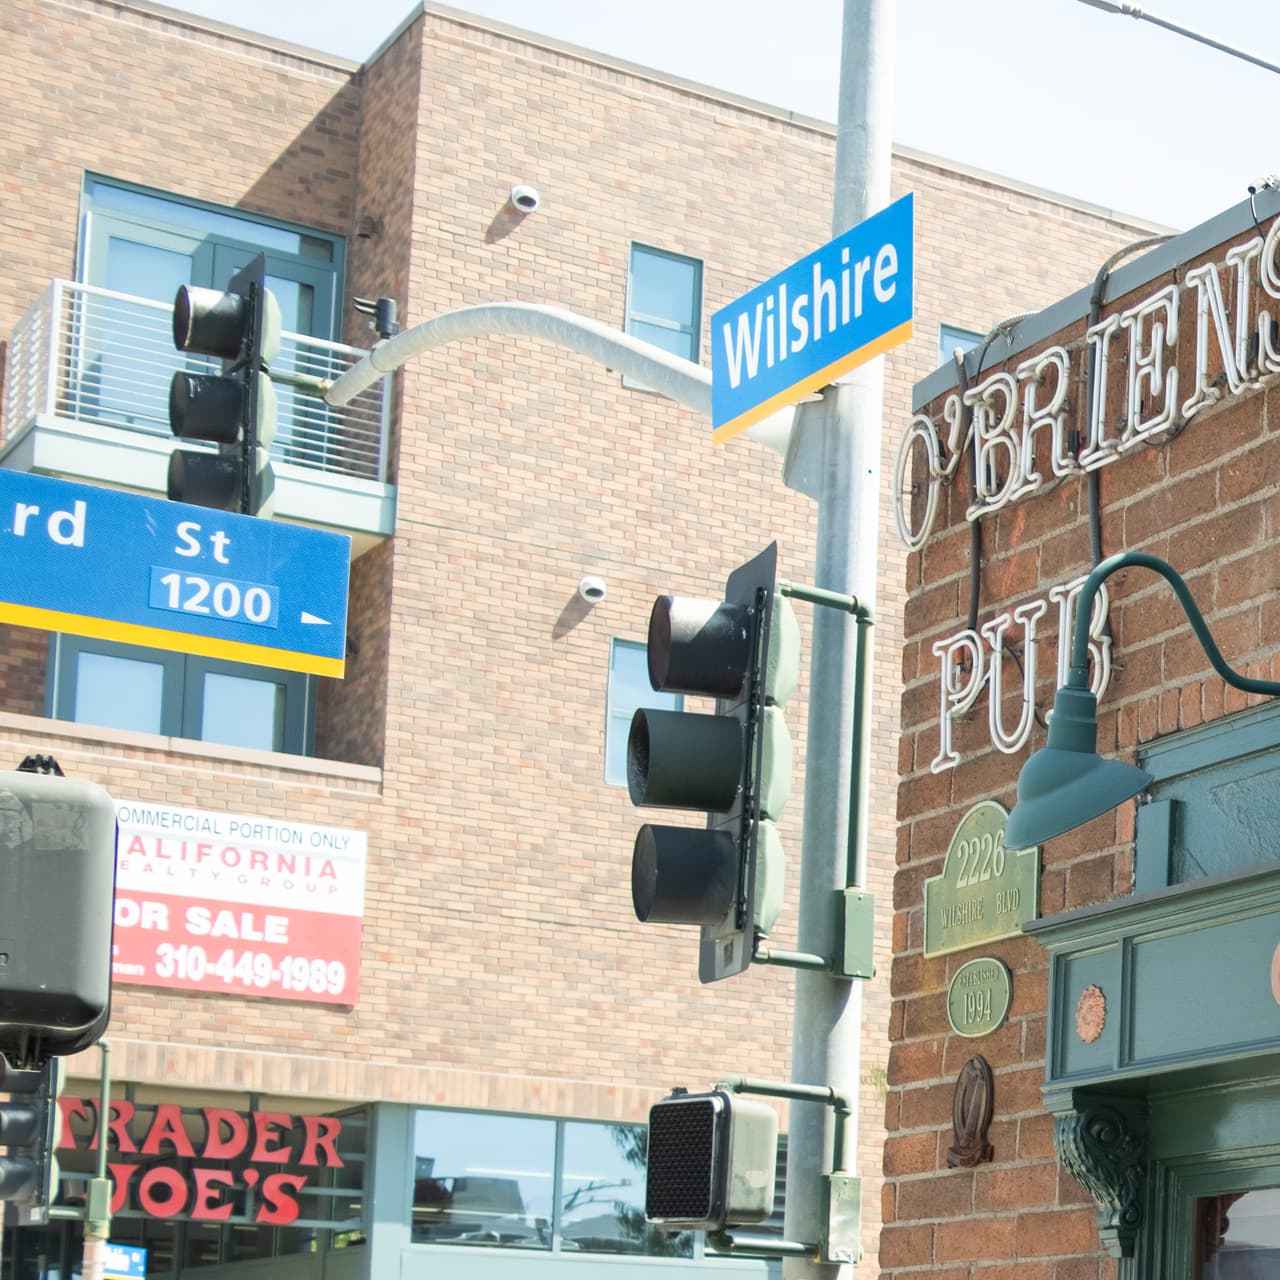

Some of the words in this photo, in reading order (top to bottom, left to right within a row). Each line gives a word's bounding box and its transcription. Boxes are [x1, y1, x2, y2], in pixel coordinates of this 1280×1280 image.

[723, 240, 900, 388] Wilshire
[175, 521, 231, 564] St
[160, 573, 272, 625] 1200
[933, 576, 1111, 774] PUB
[119, 806, 222, 835] OMMERCIAL
[229, 820, 303, 847] PORTION
[310, 831, 350, 852] ONLY
[120, 859, 221, 882] EALTY
[237, 873, 340, 895] GROUP
[127, 834, 338, 880] ALIFORNIA
[957, 828, 1005, 889] 2226
[114, 898, 168, 931] OR
[185, 905, 289, 944] SALE
[941, 896, 985, 929] WILSHIRE
[995, 887, 1021, 915] BLVD
[155, 942, 346, 995] 310-449-1989
[963, 989, 993, 1025] 1994
[57, 1096, 344, 1168] TRADER
[82, 1162, 308, 1225] JOE'S
